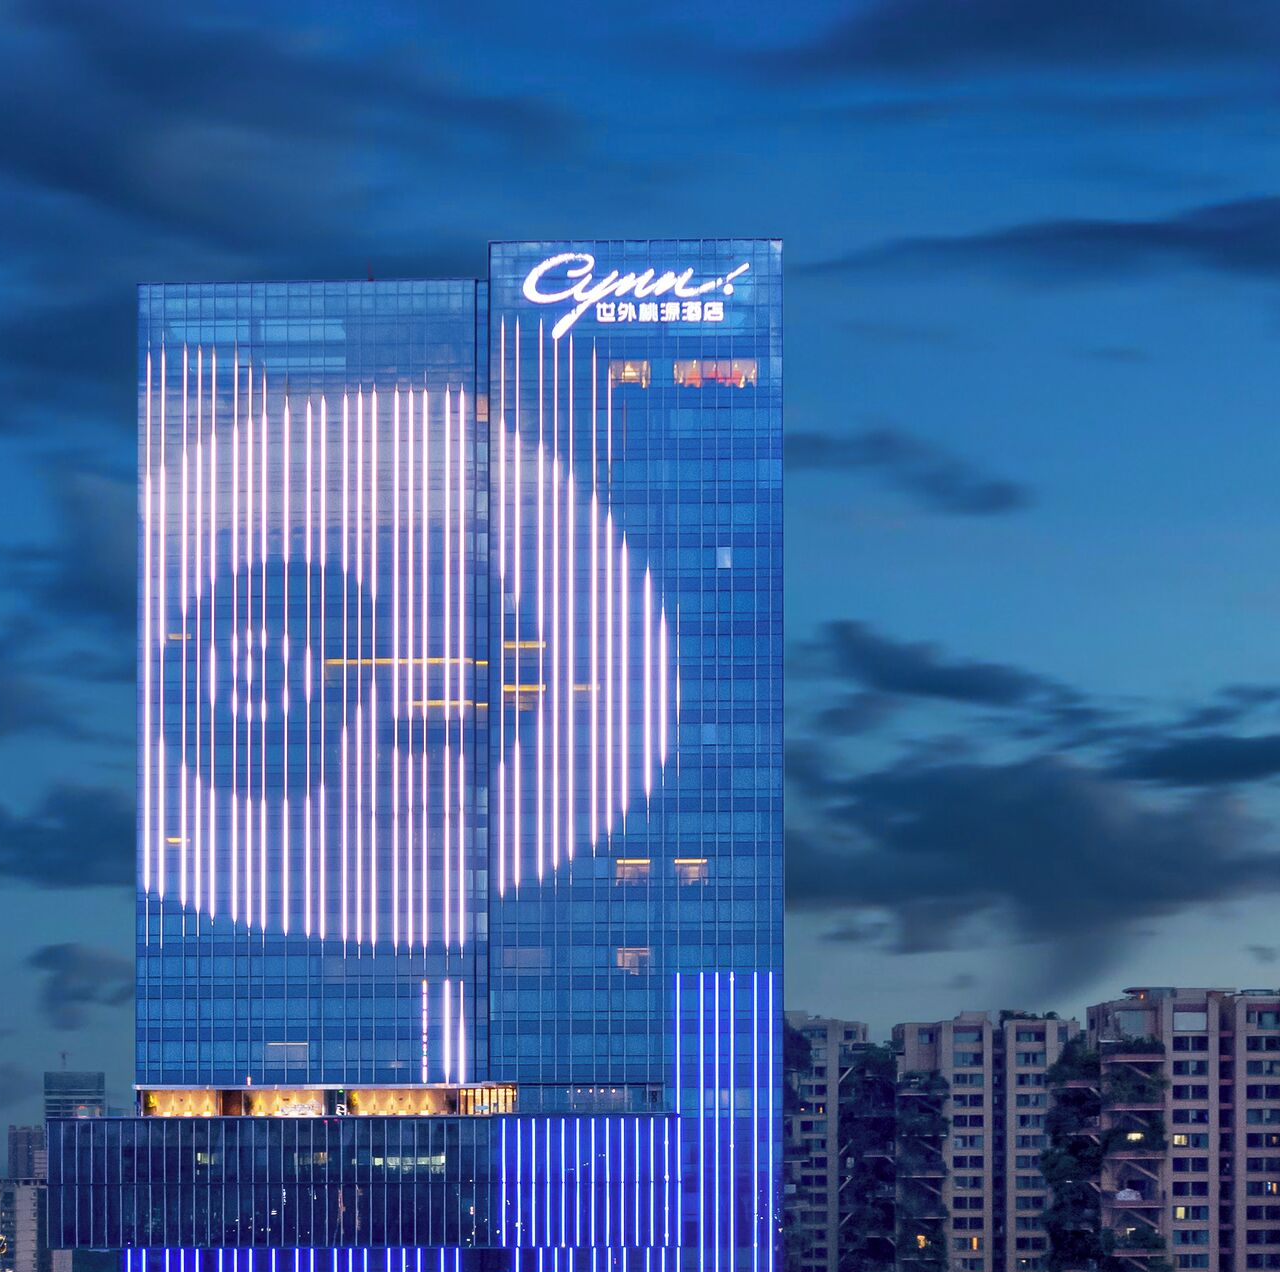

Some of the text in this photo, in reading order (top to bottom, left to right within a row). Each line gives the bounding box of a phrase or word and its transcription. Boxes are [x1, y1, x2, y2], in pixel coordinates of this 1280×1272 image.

[596, 301, 724, 323] 世外桃源酒店
